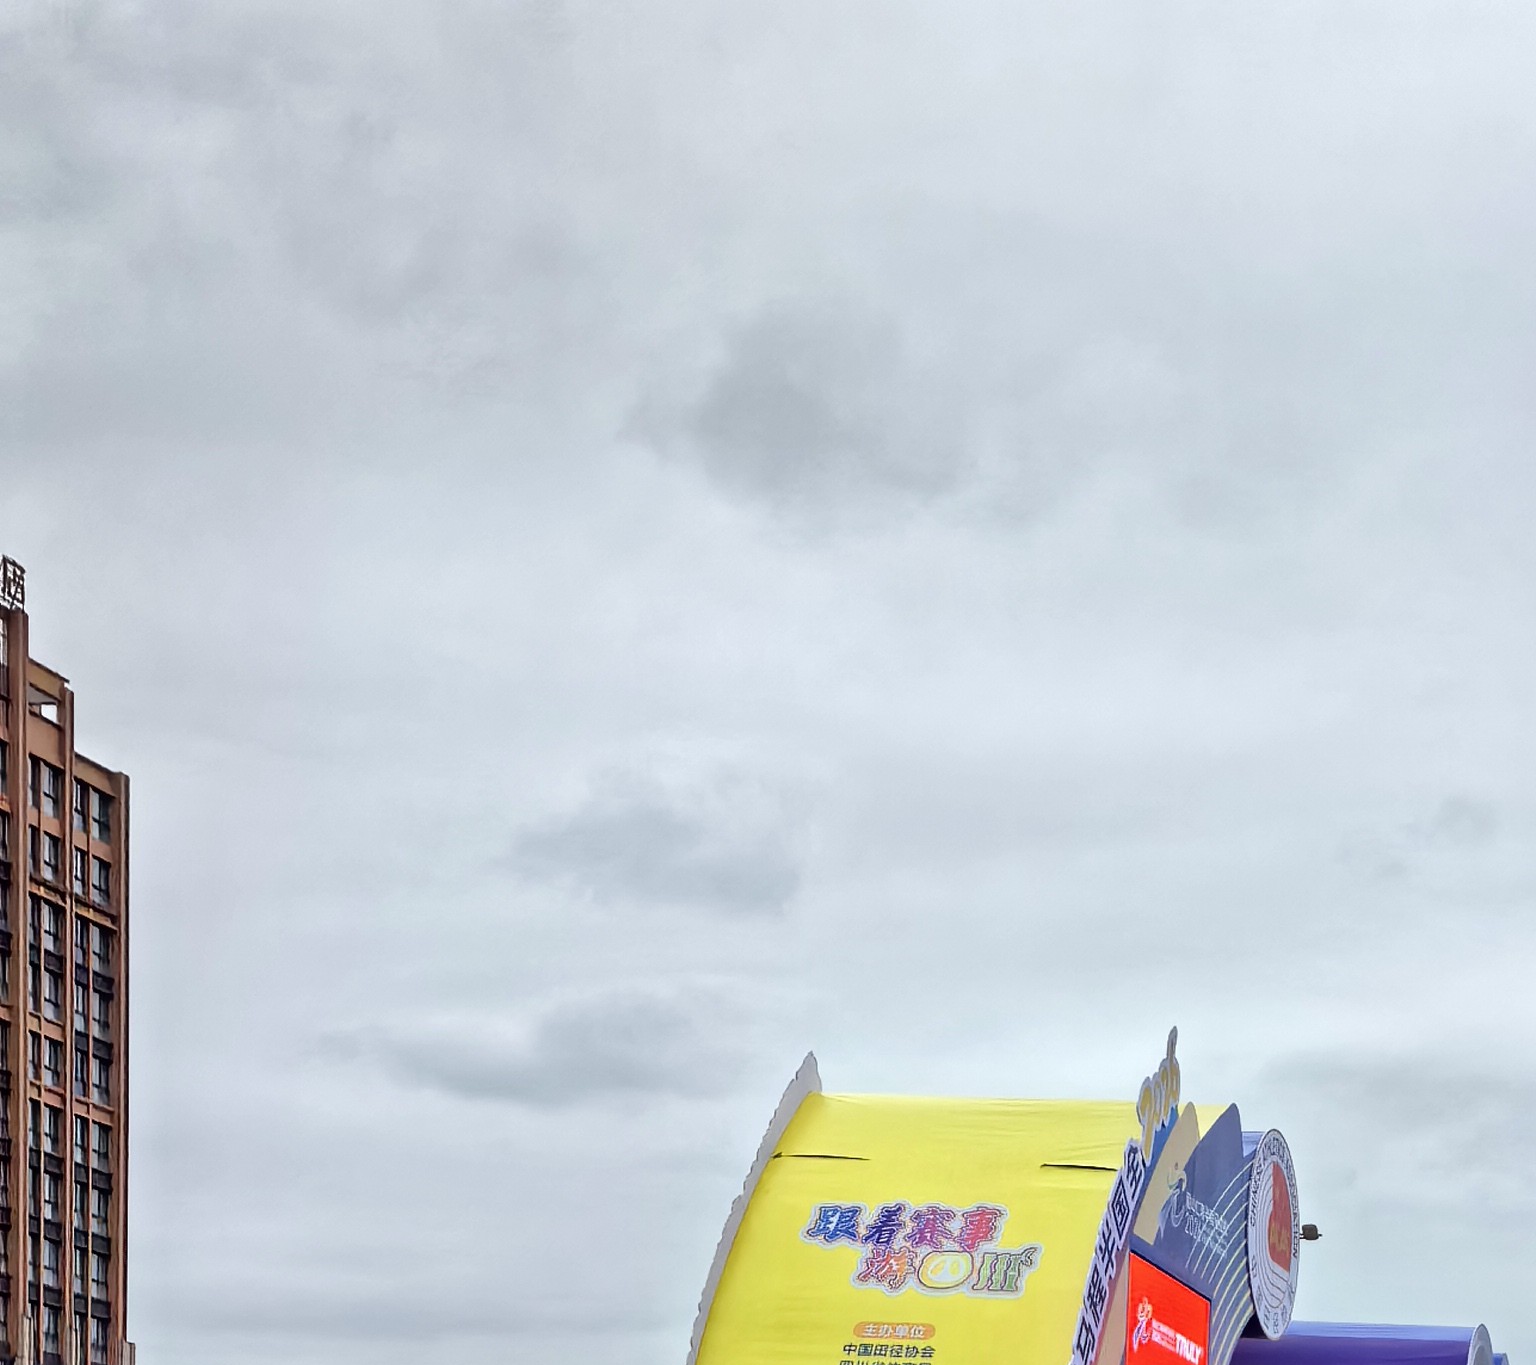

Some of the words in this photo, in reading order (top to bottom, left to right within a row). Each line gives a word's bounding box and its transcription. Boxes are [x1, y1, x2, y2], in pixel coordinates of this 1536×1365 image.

[806, 1202, 1006, 1250] 跟着赛事
[863, 1323, 926, 1338] 主办单位
[842, 1343, 936, 1359] 中国田径协会
